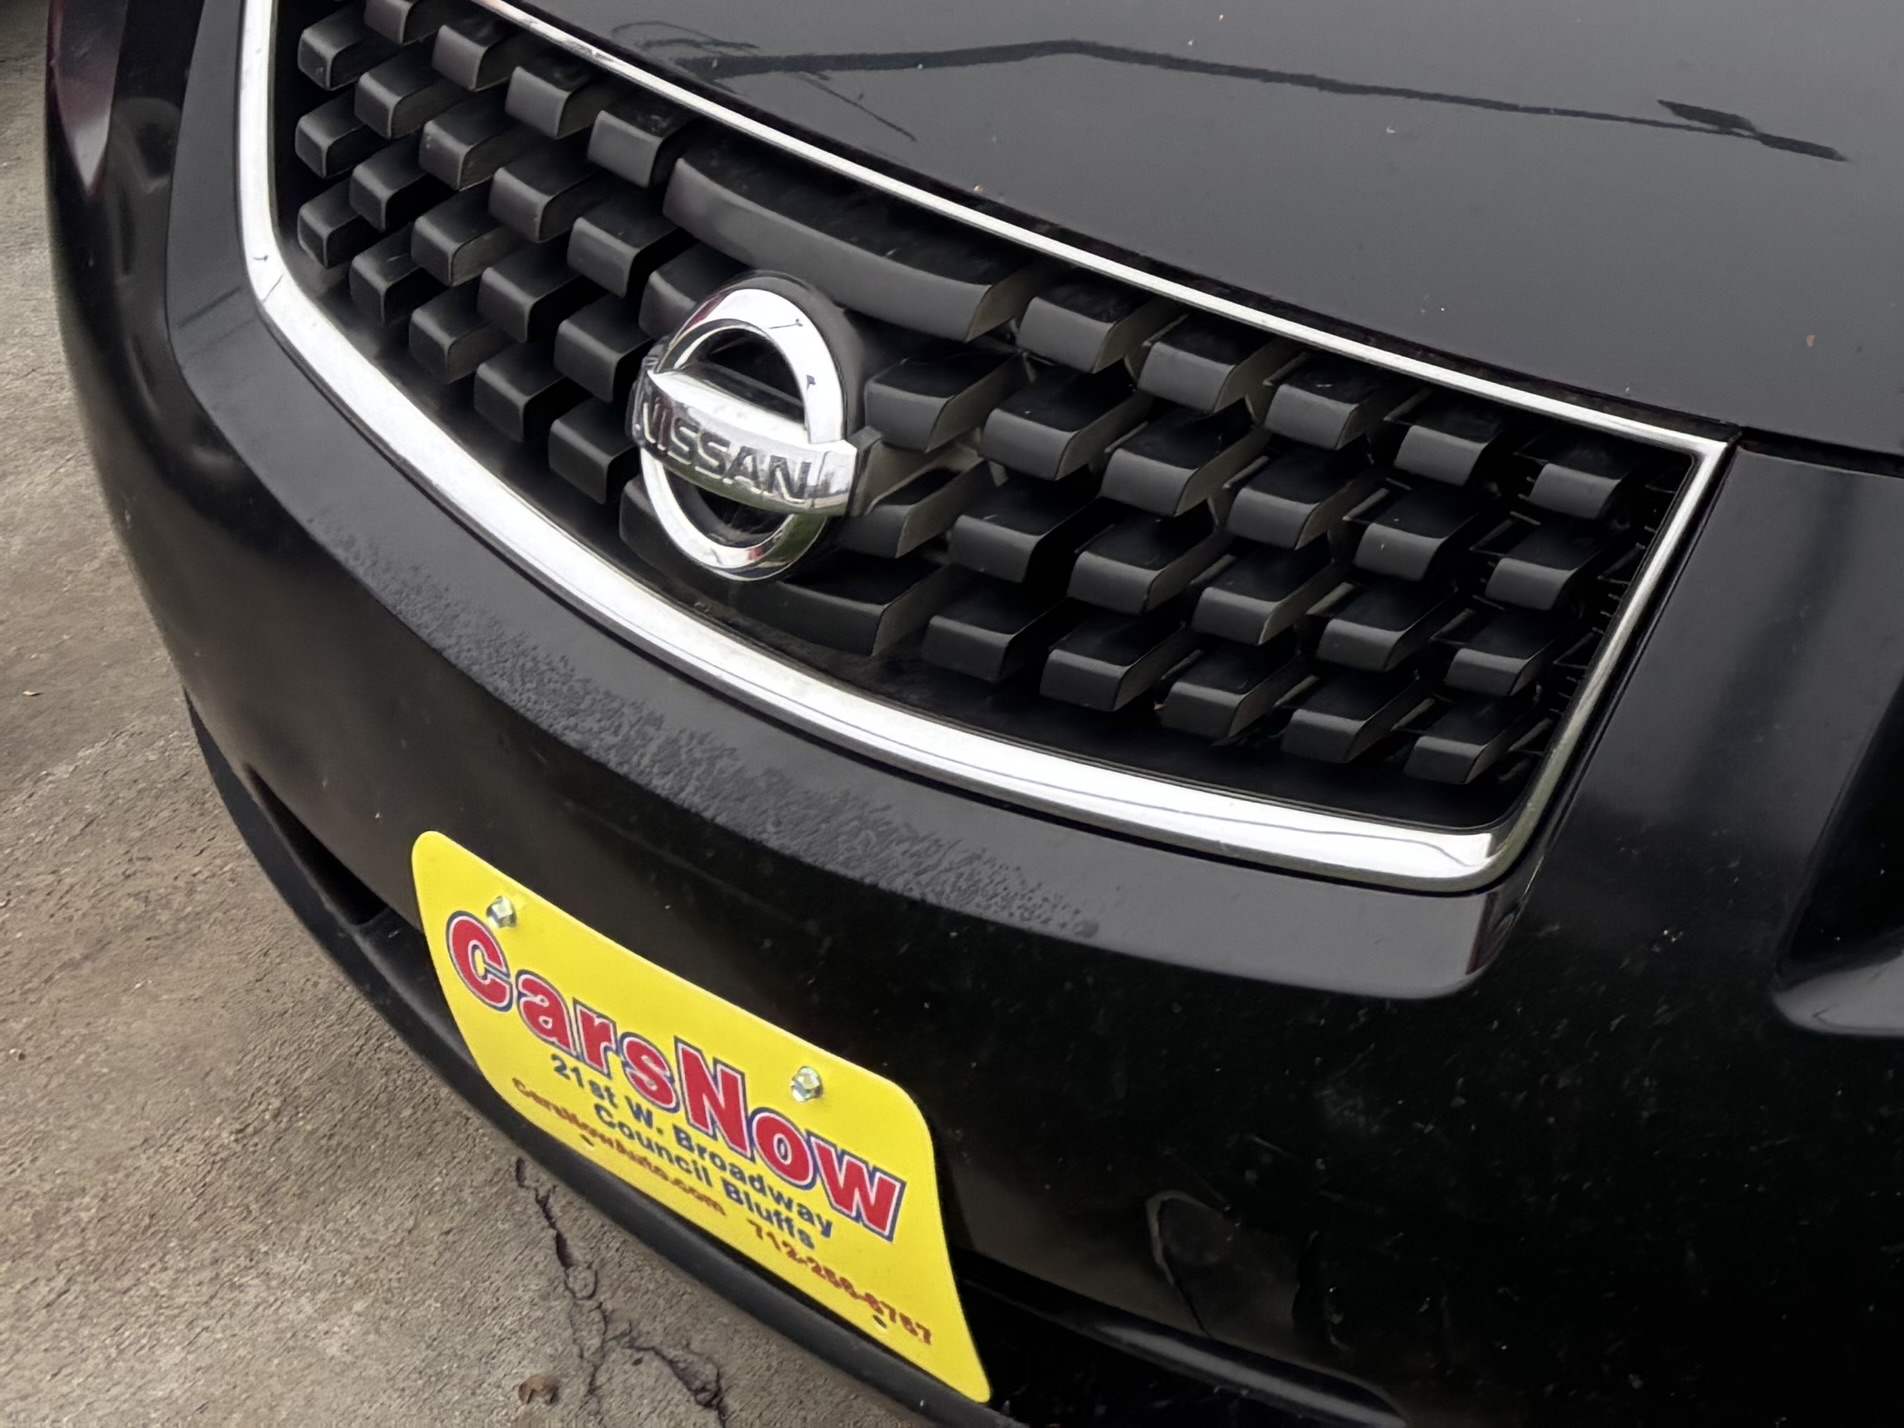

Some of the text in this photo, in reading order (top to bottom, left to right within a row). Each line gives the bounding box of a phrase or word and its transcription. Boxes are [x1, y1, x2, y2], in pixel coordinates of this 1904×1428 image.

[635, 394, 812, 505] NISSAN
[446, 910, 907, 1243] CarsNow
[594, 1103, 816, 1250] Council Bluffs
[624, 1096, 664, 1135] W.
[672, 1124, 833, 1239] Broadway
